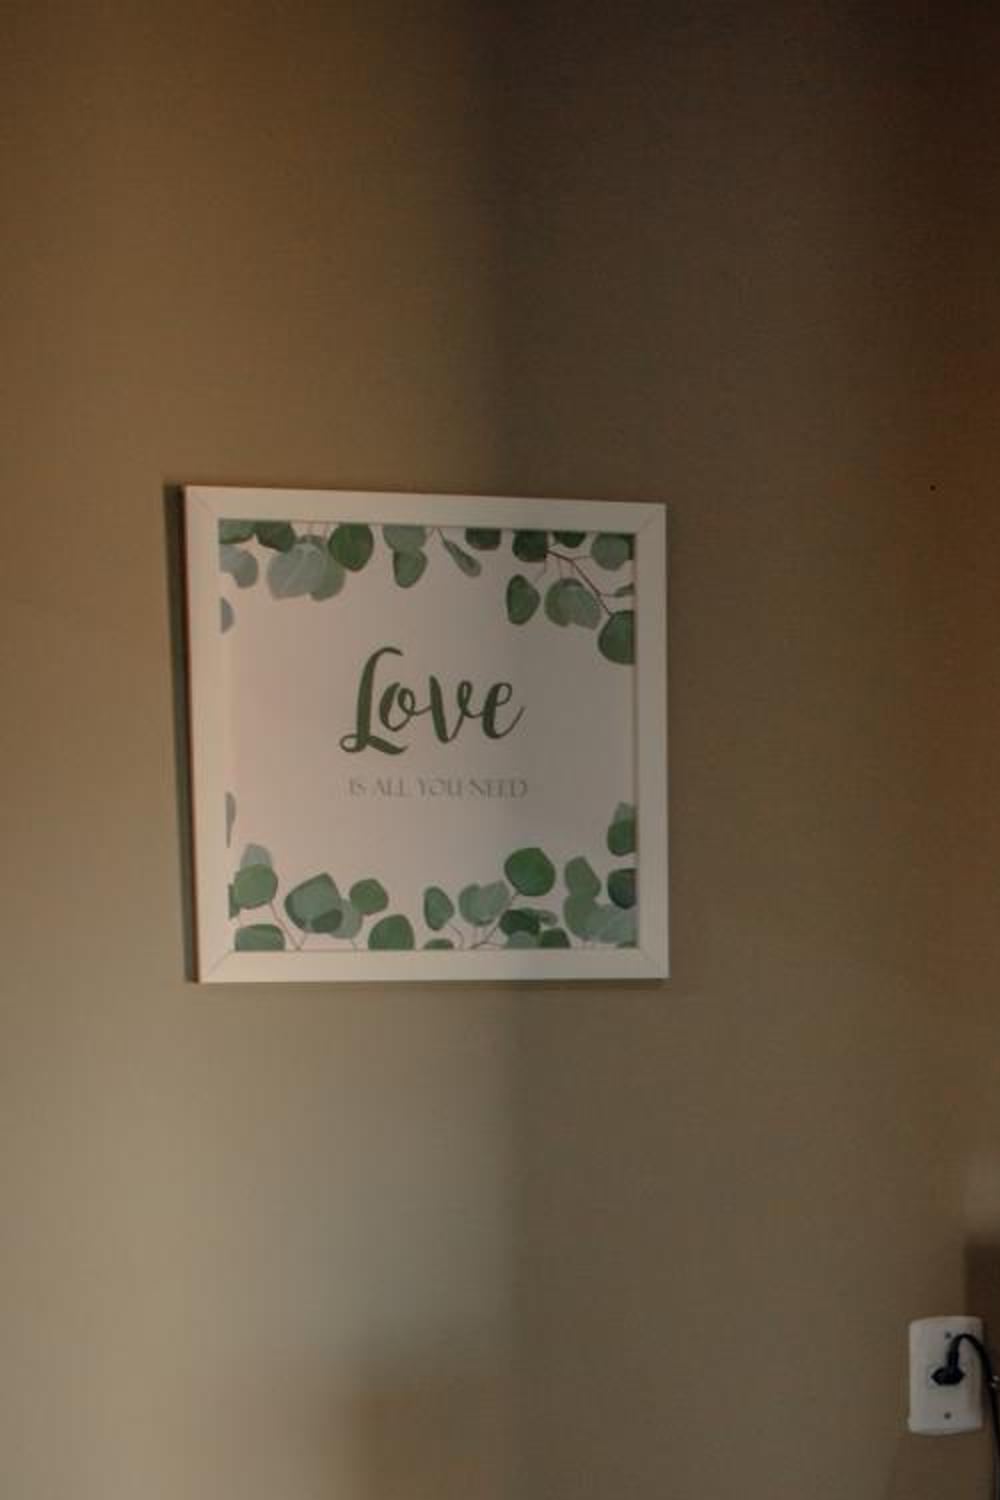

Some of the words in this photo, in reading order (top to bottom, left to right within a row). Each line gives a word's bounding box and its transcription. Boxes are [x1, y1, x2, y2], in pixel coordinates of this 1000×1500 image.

[340, 646, 526, 756] Love
[375, 776, 410, 797] ALL
[414, 776, 462, 797] YOU
[466, 776, 528, 798] NEED
